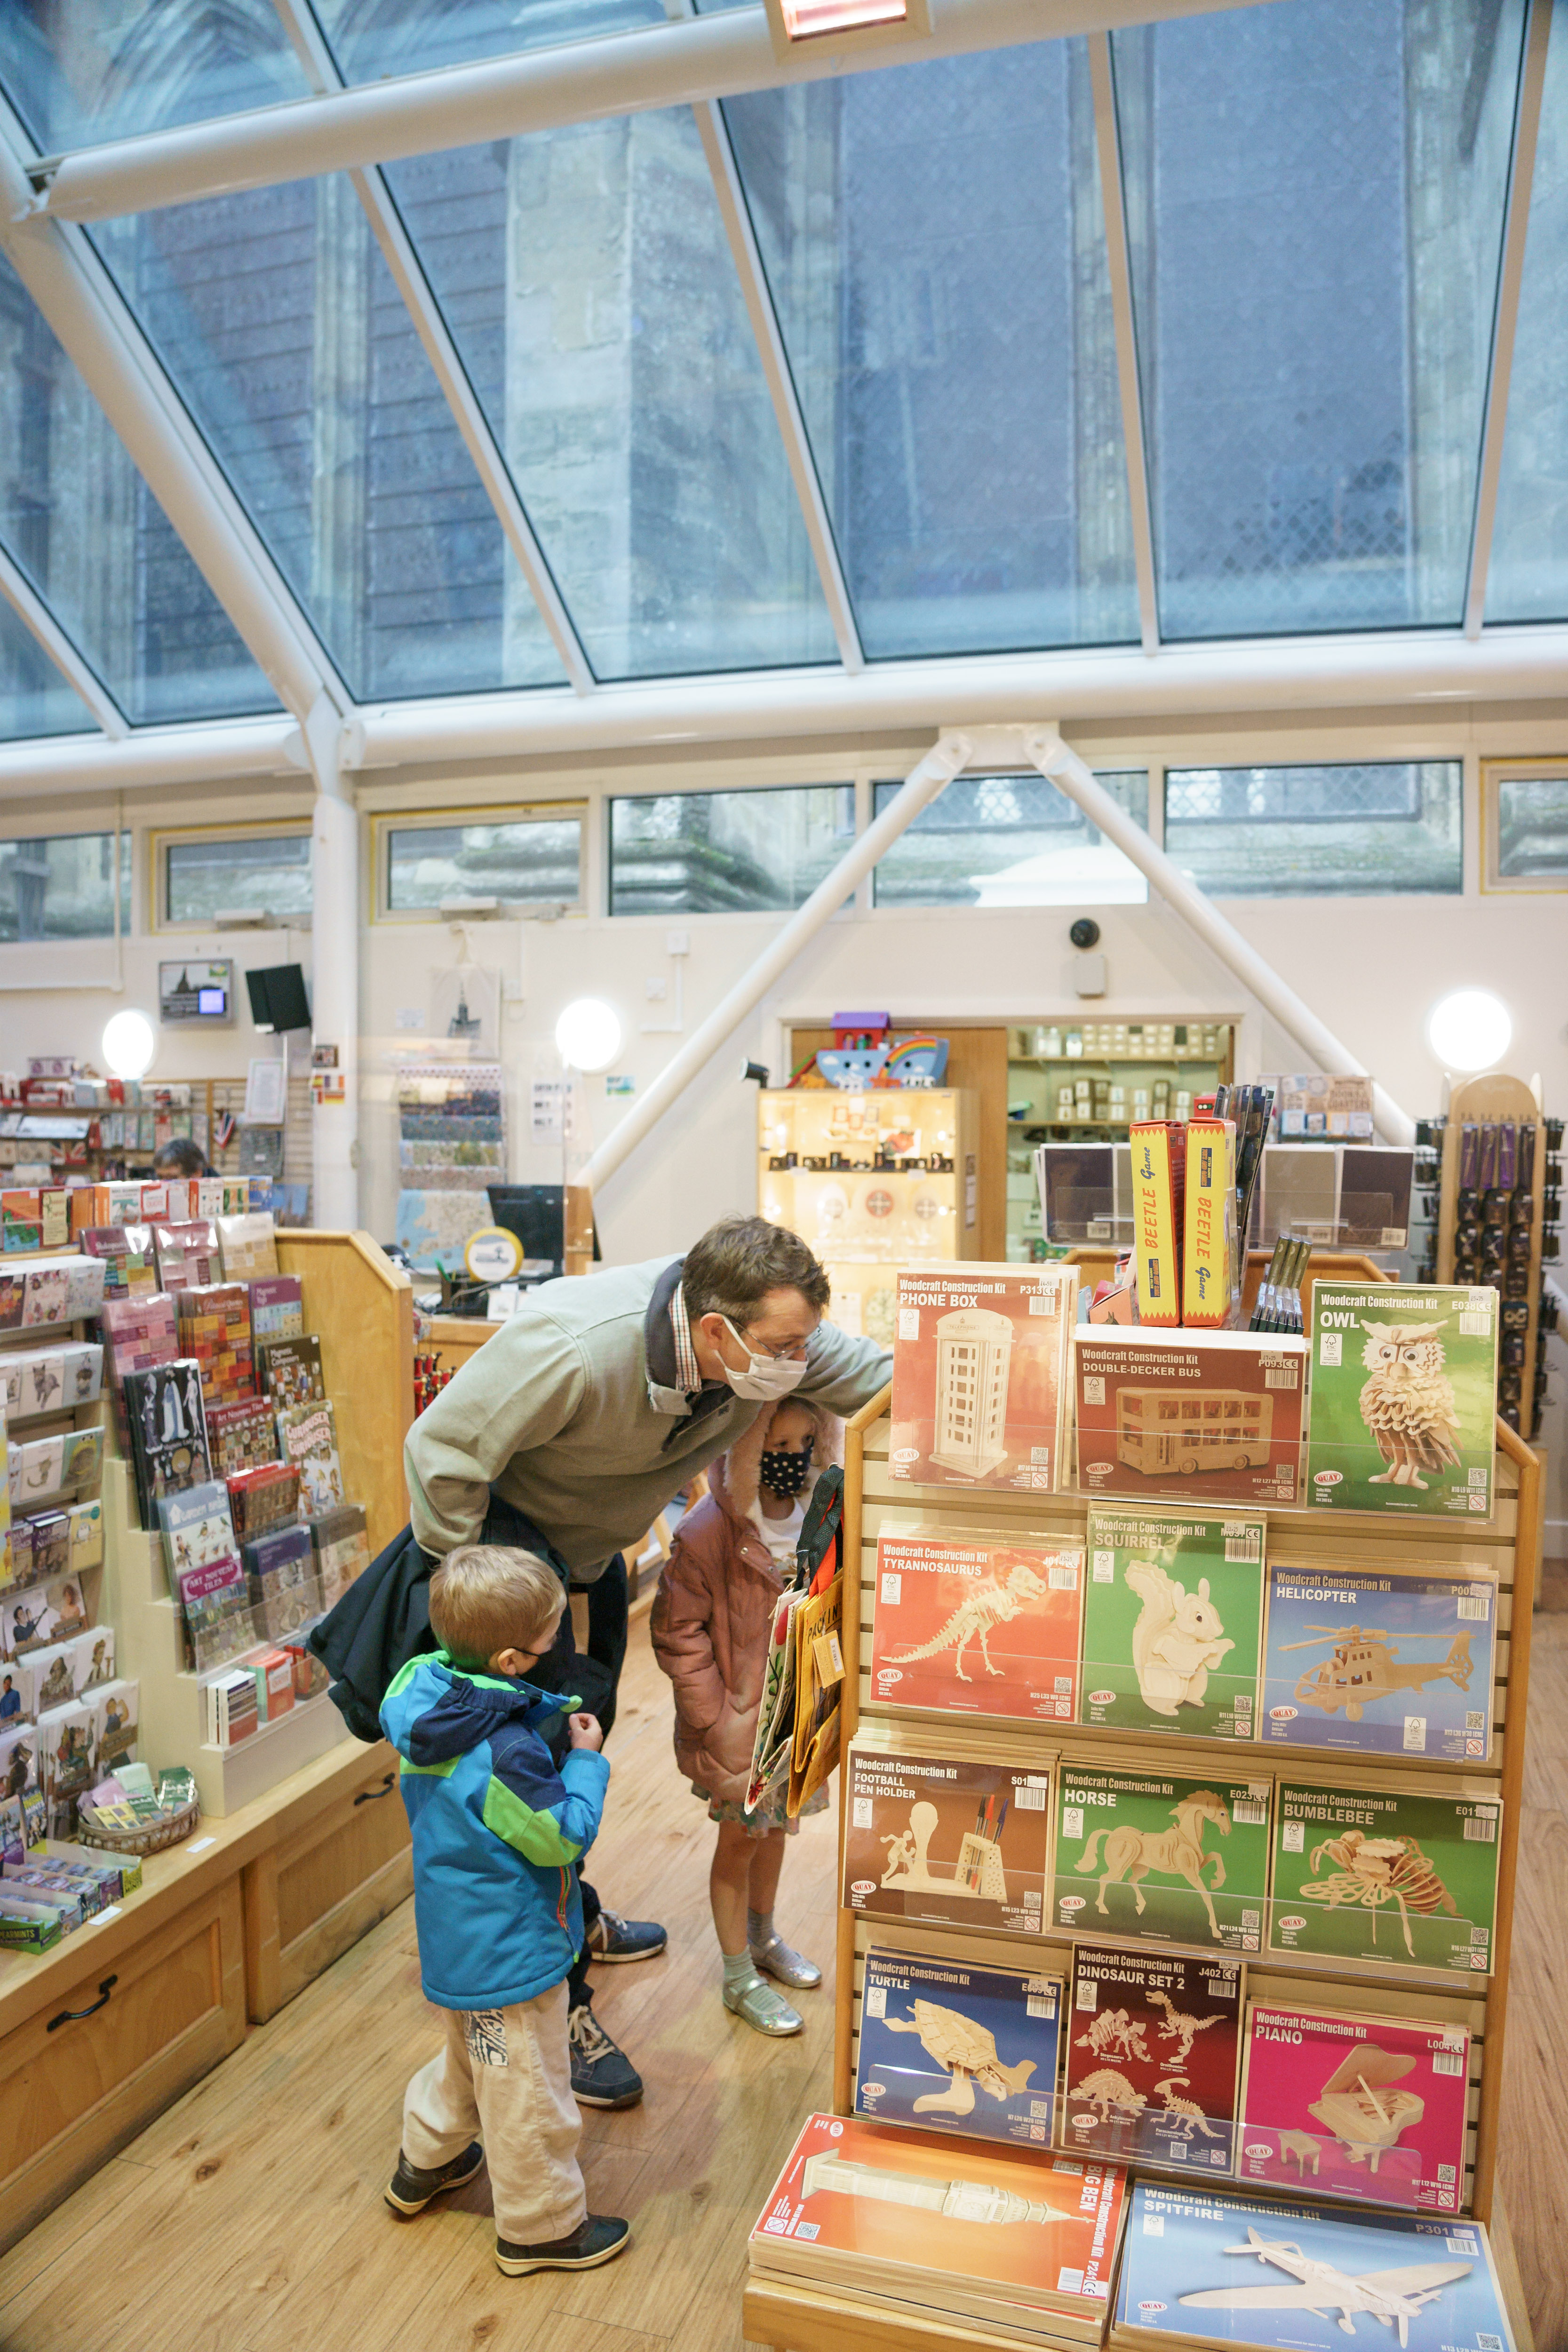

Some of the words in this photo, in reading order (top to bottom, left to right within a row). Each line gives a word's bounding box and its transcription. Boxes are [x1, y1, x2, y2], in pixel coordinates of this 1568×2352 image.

[1141, 1146, 1155, 1180] Game
[1143, 1187, 1159, 1249] BEETLE
[1197, 1197, 1211, 1259] BEETLE
[899, 1279, 940, 1292] Woodcraft
[942, 1281, 993, 1293] Construction
[995, 1283, 1006, 1294] Kit
[1020, 1285, 1042, 1295] P313
[1195, 1267, 1210, 1300] Game
[900, 1293, 946, 1306] PHONE
[950, 1295, 978, 1308] BOX
[1321, 1294, 1366, 1307] Woodcraft
[1368, 1296, 1424, 1309] Construction
[1425, 1298, 1437, 1310] Kit
[1452, 1301, 1475, 1310] E038
[1320, 1312, 1360, 1328] OWL
[1082, 1349, 1127, 1362] Woodcraft
[1129, 1351, 1185, 1364] Construction
[1186, 1354, 1198, 1365] Kit
[1083, 1363, 1176, 1375] DOUBLE-DECKER
[1179, 1367, 1201, 1377] BUS
[1096, 1519, 1138, 1532] Woodcraft
[1139, 1522, 1193, 1536] Construction
[1194, 1526, 1206, 1536] Kit
[1096, 1534, 1165, 1549] SQUIRREL
[883, 1544, 923, 1557] Woodcraft
[925, 1548, 975, 1562] Construction
[976, 1552, 987, 1563] Kit
[883, 1558, 981, 1576] TYRANNOSAURUS
[1277, 1573, 1321, 1586] Woodcraft
[1322, 1576, 1378, 1590] Construction
[1379, 1580, 1391, 1592] Kit
[1451, 1586, 1471, 1595] P00
[1277, 1587, 1356, 1604] HELICOPTER
[808, 1602, 841, 1645] PACKIN
[855, 1758, 894, 1773] Woodcraft
[896, 1763, 945, 1778] Construction
[946, 1768, 957, 1779] Kit
[855, 1773, 905, 1787] FOOTBALL
[1066, 1773, 1107, 1788] Woodcraft
[1109, 1778, 1161, 1793] Construction
[1162, 1784, 1173, 1795] Kit
[854, 1784, 874, 1794] PEN
[876, 1787, 915, 1799] HOLDER
[1065, 1789, 1116, 1807] HORSE
[1284, 1790, 1328, 1805] Woodcraft
[1329, 1795, 1384, 1811] Construction
[1385, 1801, 1397, 1812] Kit
[1284, 1804, 1374, 1825] BUMBLEBEE
[1456, 1806, 1477, 1816] E01
[1079, 1950, 1119, 1965] Woodcraft
[1121, 1955, 1172, 1972] Construction
[1174, 1963, 1185, 1973] Kit
[869, 1974, 909, 1989] TURTLE
[871, 1960, 909, 1976] Woodcraft
[910, 1966, 958, 1983] Construction
[960, 1973, 970, 1985] Kit
[1078, 1964, 1144, 1984] DINOSAUR
[1149, 1974, 1173, 1987] SET
[1177, 1978, 1185, 1989] 2
[1199, 1967, 1220, 1978] J402
[1256, 2025, 1303, 2044] PIANO
[1257, 2011, 1299, 2028] Woodcraft
[1301, 2018, 1354, 2036] Construction
[1355, 2026, 1367, 2039] Kit
[1156, 2128, 1189, 2137] Parasaurolophus
[1084, 2165, 1103, 2185] BIG
[1101, 2168, 1118, 2201] Woodcraft
[1079, 2186, 1099, 2211] BEN
[1145, 2188, 1211, 2207] Woodcraft
[1215, 2198, 1299, 2218] Construction
[1302, 2210, 1321, 2221] Kit
[1144, 2200, 1223, 2221] SPITFIRE
[1093, 2201, 1112, 2246] Construction
[1416, 2224, 1449, 2235] P301
[1091, 2247, 1104, 2257] Kit
[1086, 2260, 1099, 2281] P241
